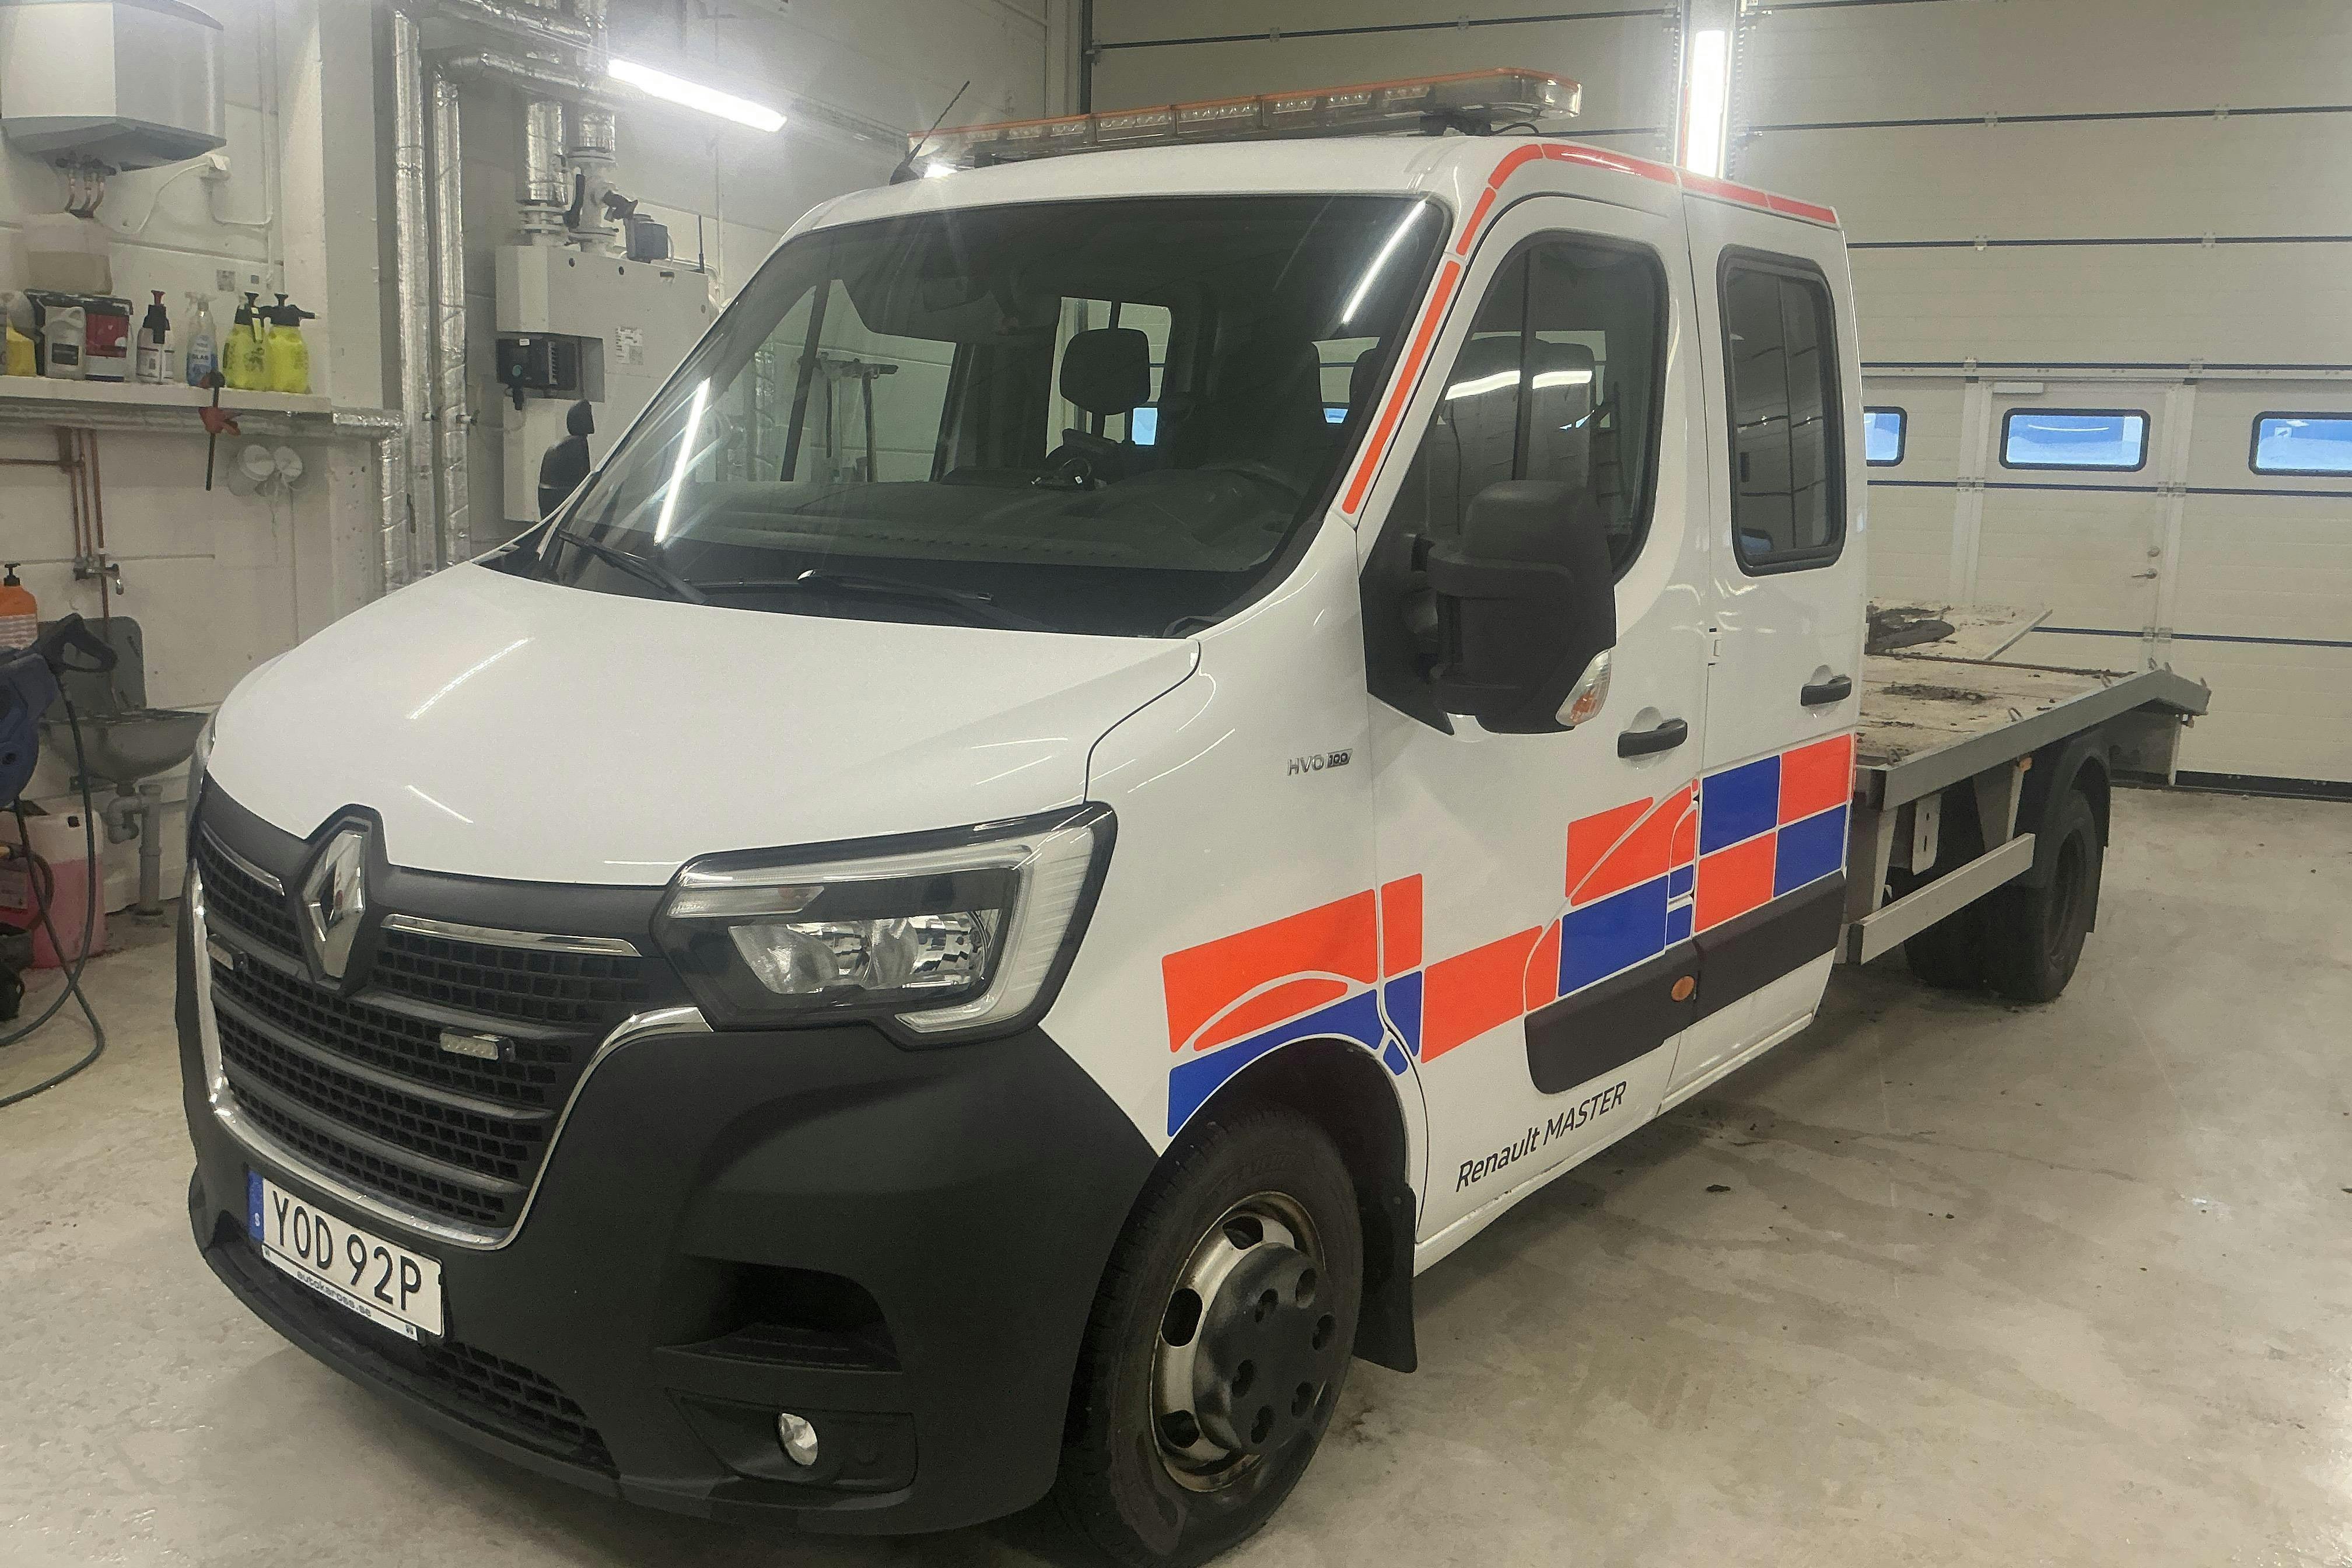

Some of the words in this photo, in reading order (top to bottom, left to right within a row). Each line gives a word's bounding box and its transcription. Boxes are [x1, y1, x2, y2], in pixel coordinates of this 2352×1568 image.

[1287, 754, 1324, 776] HVO
[1328, 751, 1349, 766] 100
[1456, 1127, 1540, 1193] Renault
[1543, 1081, 1627, 1146] MASTER
[273, 1191, 333, 1270] YOD
[347, 1234, 422, 1310] 92P
